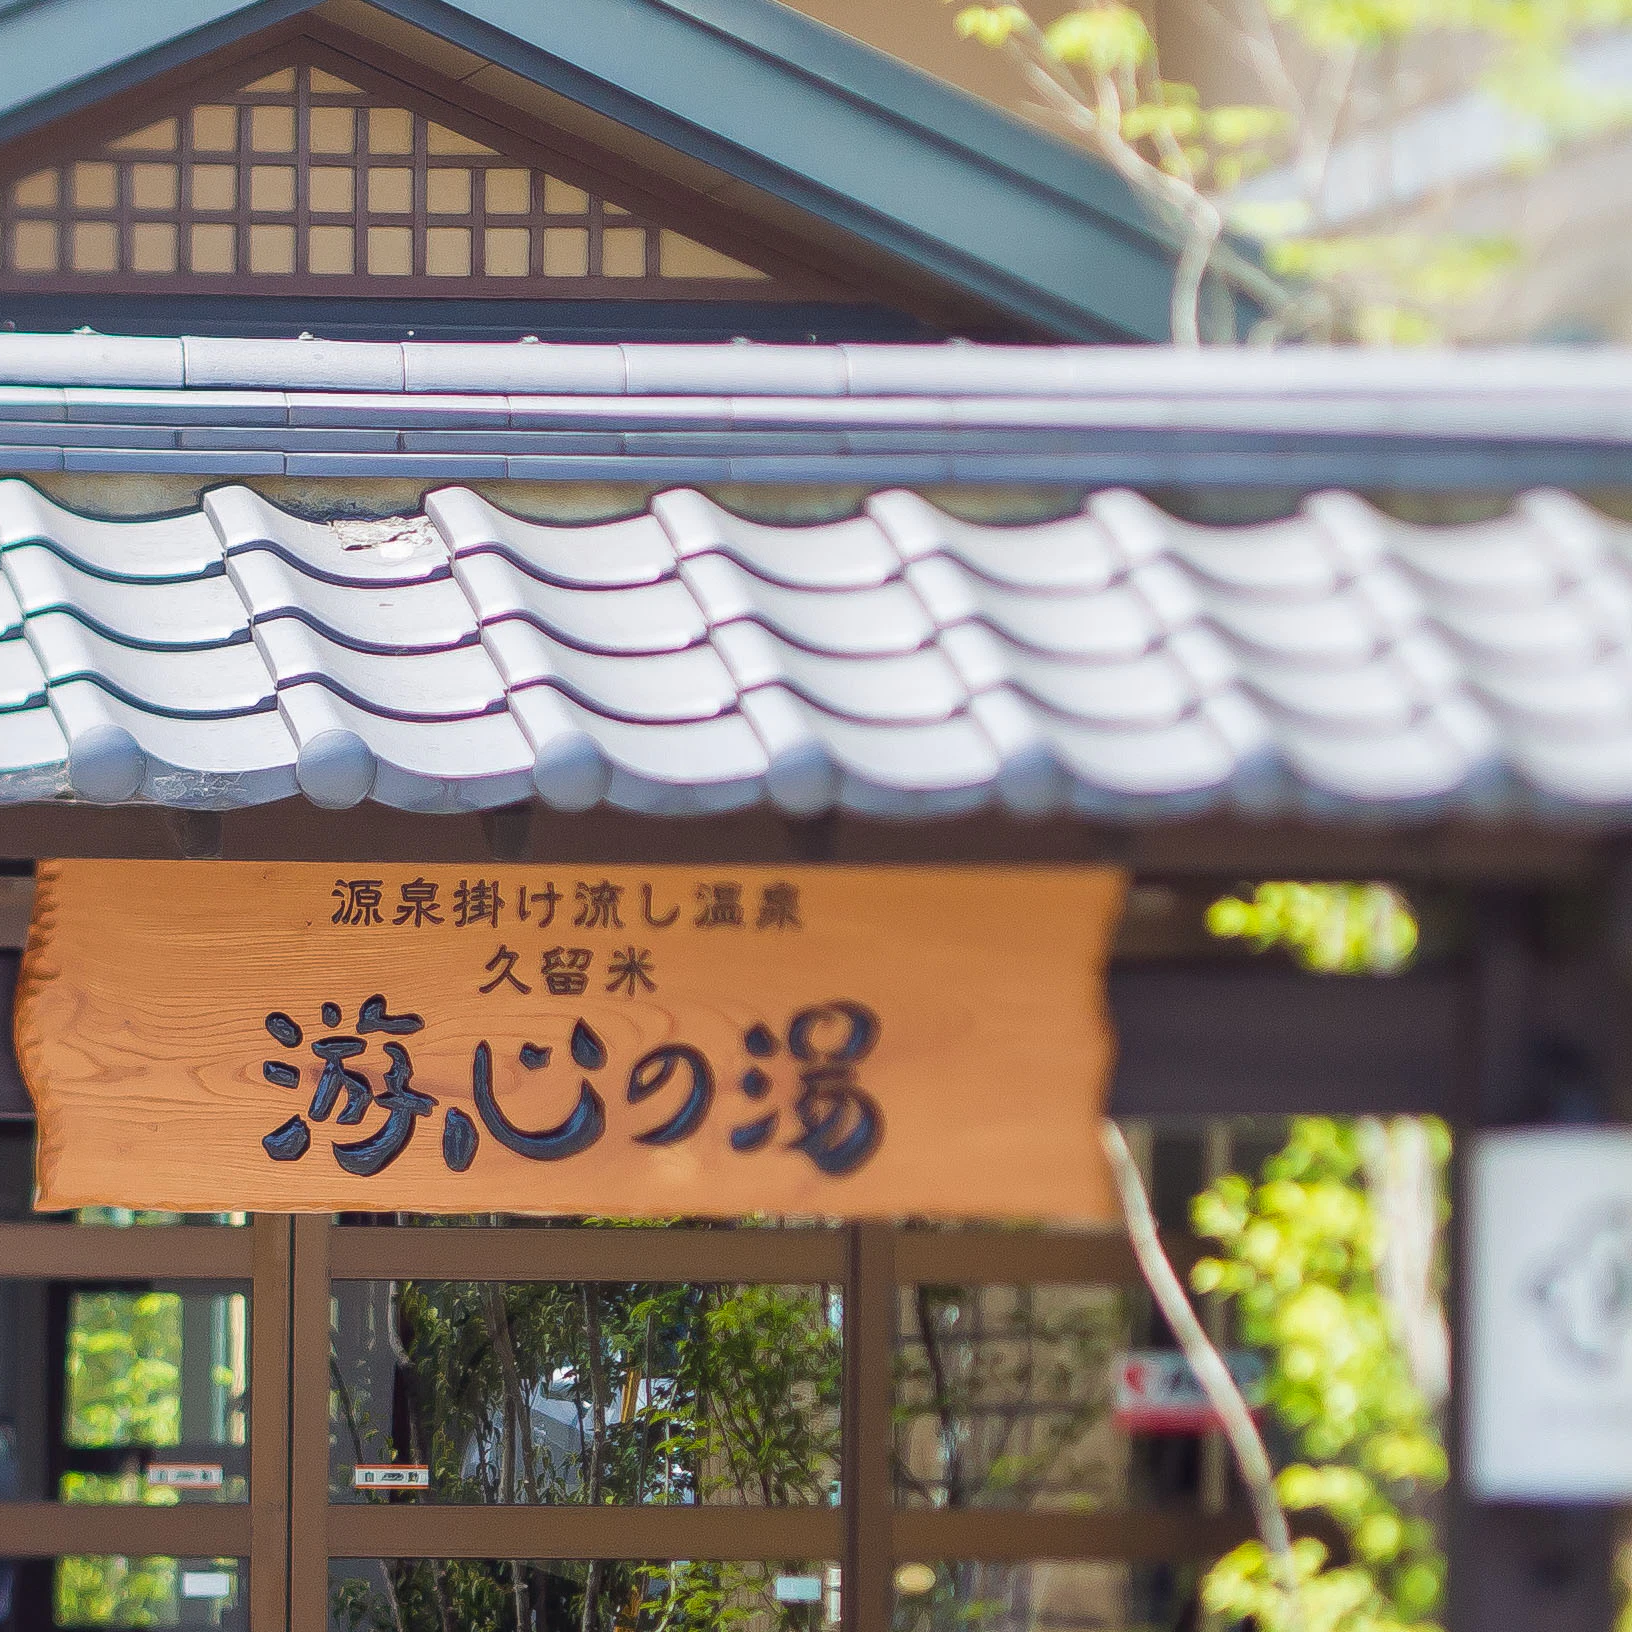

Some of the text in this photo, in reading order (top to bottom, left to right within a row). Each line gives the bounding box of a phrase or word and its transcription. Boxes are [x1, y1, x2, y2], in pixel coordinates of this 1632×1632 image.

[331, 877, 804, 930] 源泉掛け流し温泉
[479, 944, 657, 995] 久留米
[262, 993, 883, 1177] 游心の湯
